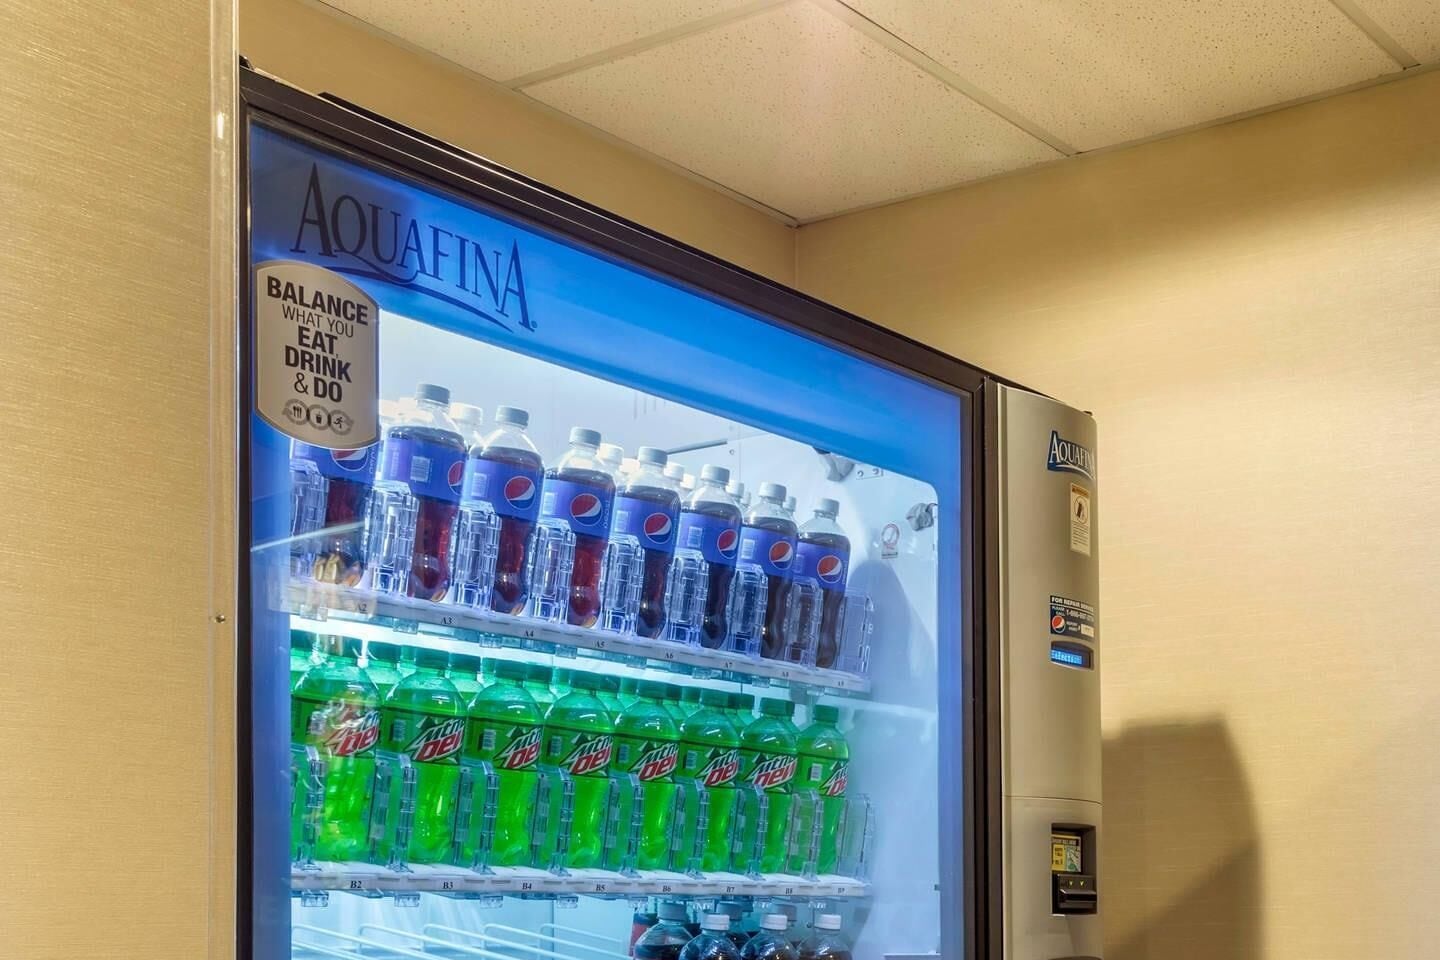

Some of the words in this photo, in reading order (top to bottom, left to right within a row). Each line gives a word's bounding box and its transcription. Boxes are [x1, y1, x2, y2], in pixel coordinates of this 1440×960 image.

[290, 162, 537, 332] AQUAFINA
[267, 276, 369, 326] BALANCE
[282, 304, 323, 327] WHAT
[327, 318, 354, 338] YOU
[285, 345, 352, 383] DRINK
[294, 372, 309, 394] &
[314, 376, 342, 403] DO
[349, 879, 363, 891] B2
[442, 880, 454, 891] B3
[521, 882, 533, 891] B4
